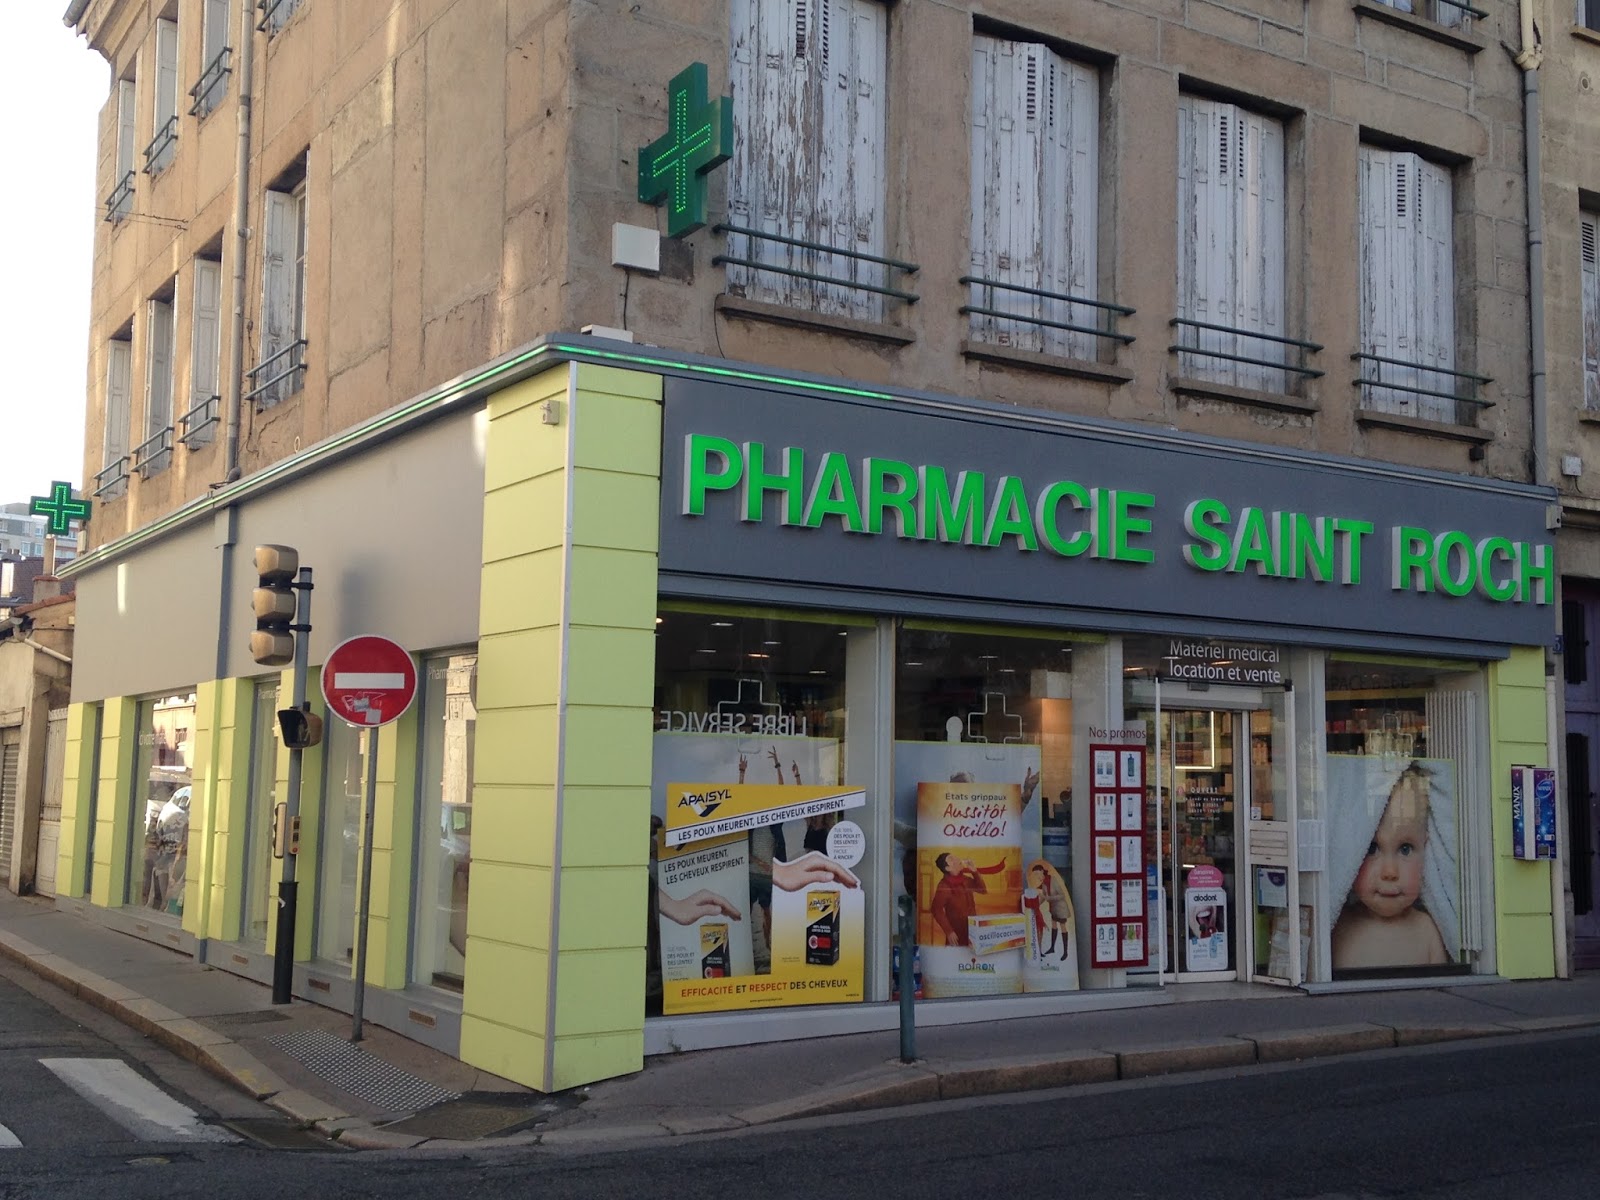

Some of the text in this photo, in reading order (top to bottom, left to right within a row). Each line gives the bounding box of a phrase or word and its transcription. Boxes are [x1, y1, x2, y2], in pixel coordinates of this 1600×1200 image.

[682, 433, 1554, 605] PHARMACIE SAINT ROCH
[1170, 659, 1281, 683] location et vente
[1089, 726, 1147, 741] Nos promos
[678, 788, 732, 808] APAISYL
[971, 793, 1007, 802] grippaux
[1513, 785, 1521, 820] MANIX
[943, 803, 1007, 819] Aussitôt
[678, 831, 692, 841] LES
[693, 825, 716, 838] POUX
[717, 817, 755, 833] MEURENT,
[756, 814, 770, 825] LES
[771, 806, 806, 822] CHEVEUX
[664, 862, 676, 873] LES
[677, 857, 696, 869] POUX
[666, 874, 678, 885] LES
[679, 866, 710, 881] CHEVEUX
[958, 958, 996, 972] BOIRON
[735, 984, 747, 994] ET
[749, 982, 788, 993] RESPECT
[790, 981, 807, 990] DES
[808, 979, 848, 989] CHEVEUX
